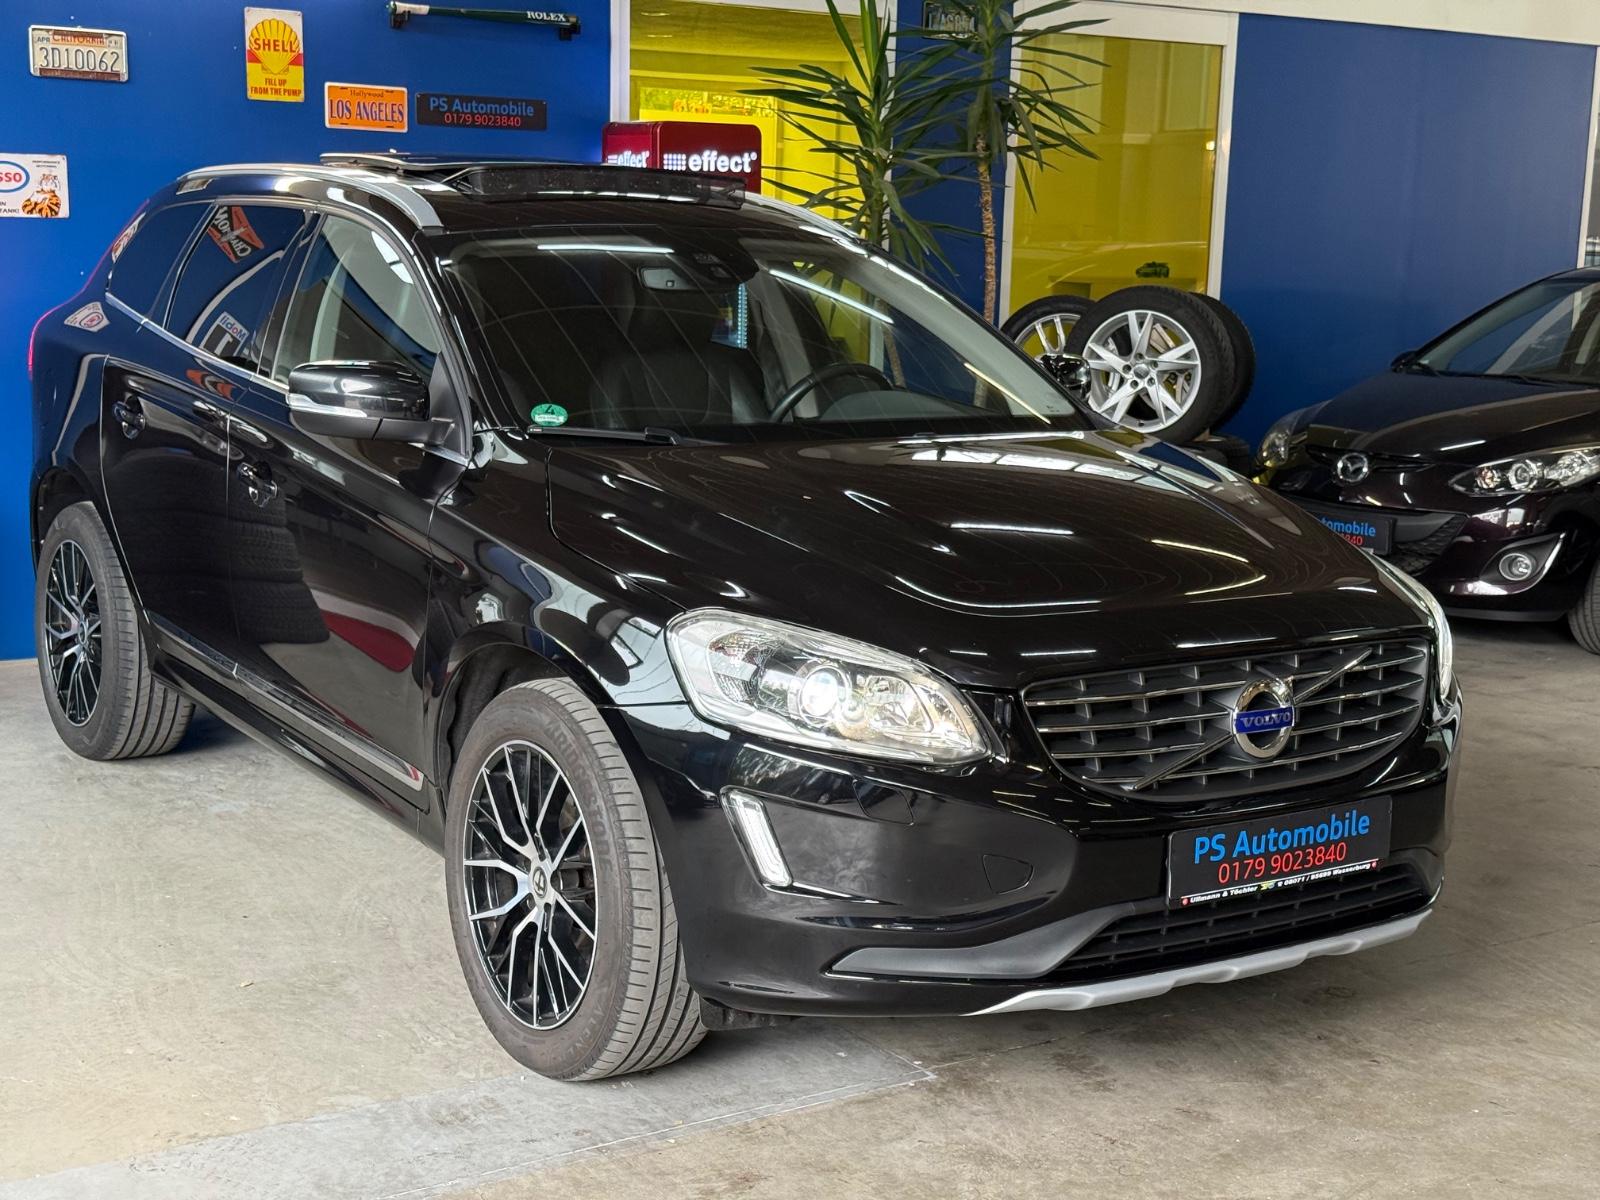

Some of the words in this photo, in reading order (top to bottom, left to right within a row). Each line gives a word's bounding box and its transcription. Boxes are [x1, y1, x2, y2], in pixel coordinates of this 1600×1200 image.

[526, 11, 566, 22] ROLEX
[253, 38, 296, 53] SHELL
[39, 46, 120, 72] 3D10062
[265, 78, 278, 86] FILL
[278, 79, 287, 87] UP
[250, 86, 269, 95] FROM
[270, 87, 282, 96] THE
[283, 88, 302, 97] PUMP
[350, 90, 384, 98] Hollywood
[329, 99, 351, 119] LOS
[355, 101, 404, 122] ANGELES
[429, 97, 448, 112] PS
[452, 99, 535, 117] Automobile
[444, 113, 472, 125] 0179
[474, 115, 521, 127] 9023840
[1321, 517, 1376, 537] tomobile
[1240, 712, 1291, 728] VOLVO
[1194, 833, 1226, 864] PS
[1232, 809, 1370, 858] Automobile
[1218, 857, 1265, 884] 0179
[1270, 842, 1347, 875] 9023840
